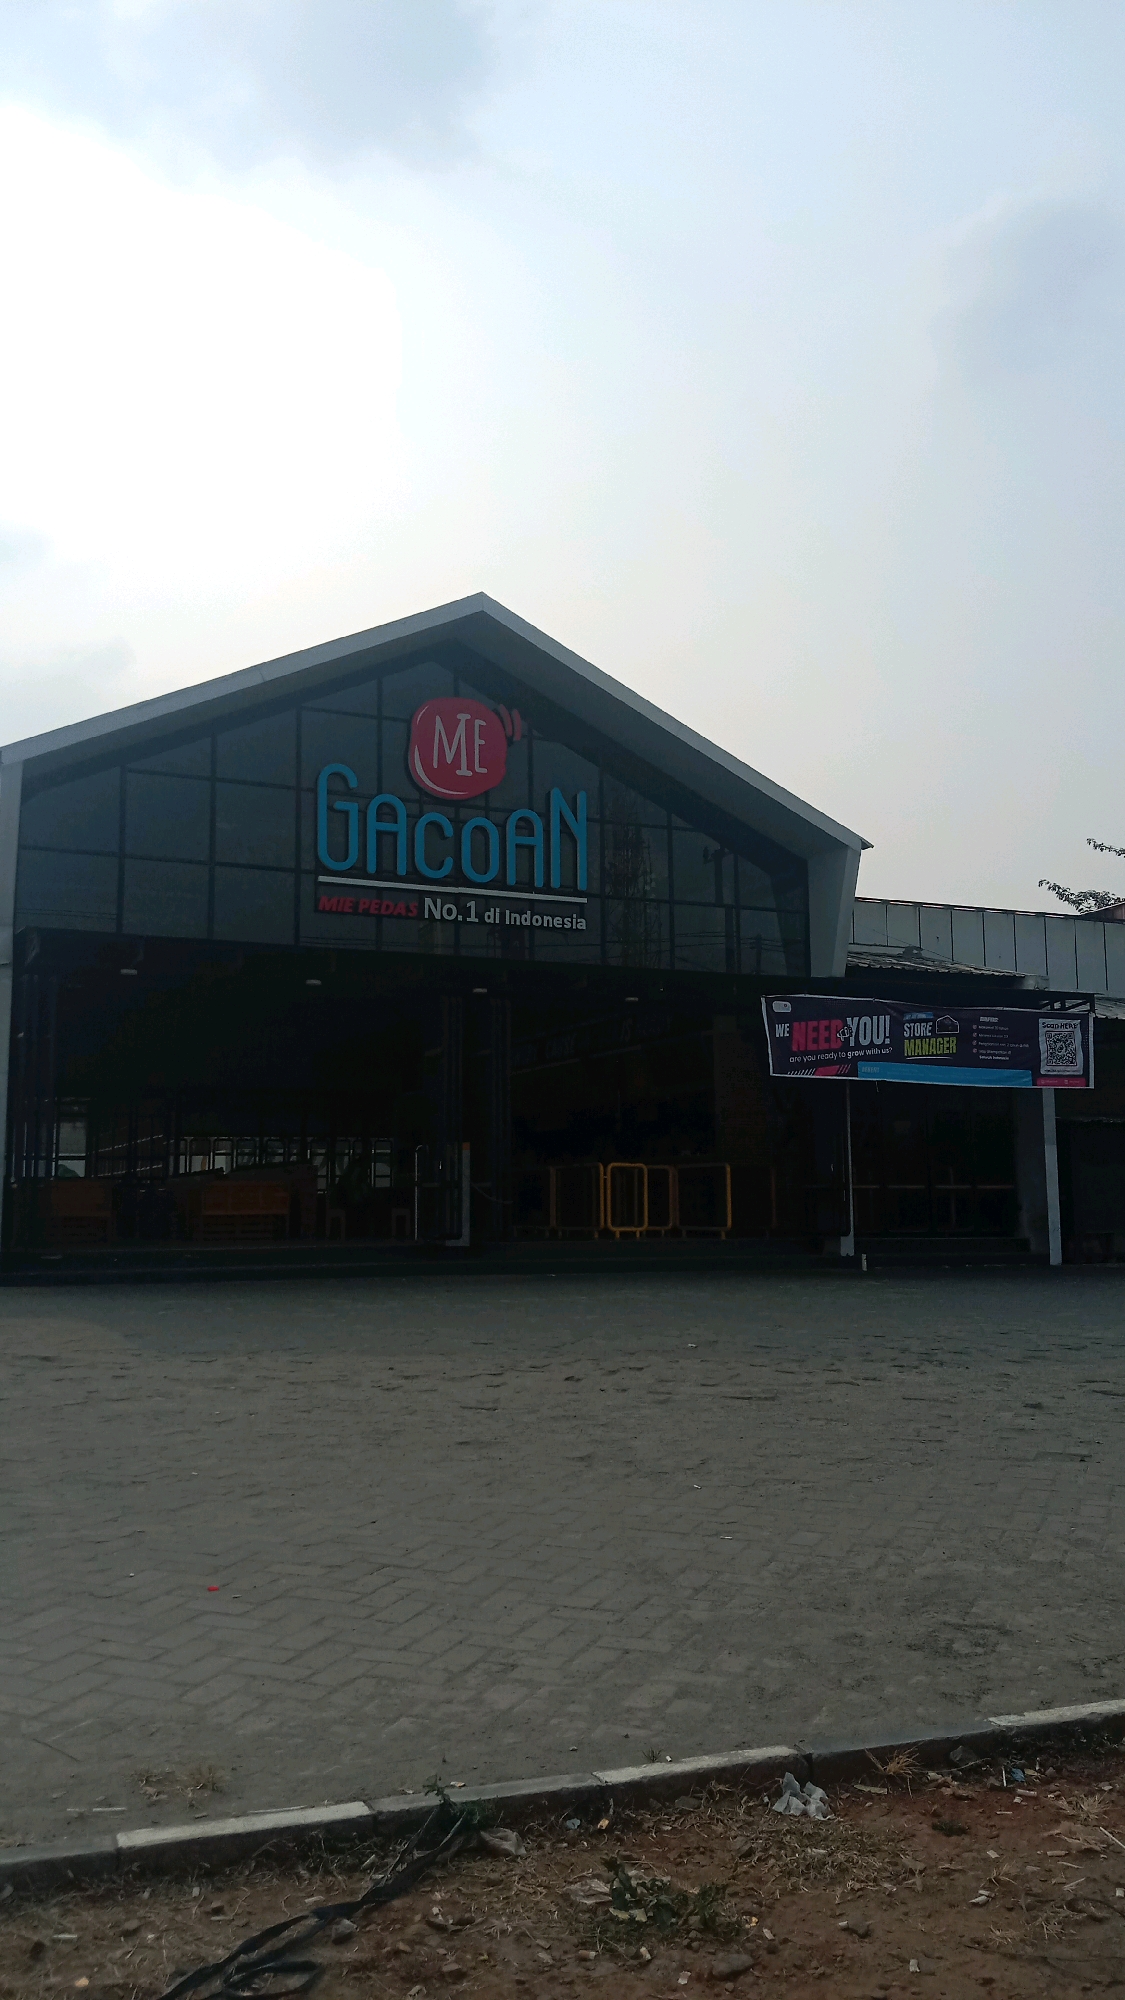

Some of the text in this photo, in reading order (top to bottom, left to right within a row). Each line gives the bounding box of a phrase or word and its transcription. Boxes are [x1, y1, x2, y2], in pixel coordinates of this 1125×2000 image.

[317, 762, 588, 891] GACOAN
[318, 895, 587, 930] MIE PEDAS No.1 di Indonesia
[775, 1014, 891, 1052] WE NEED YOU!
[903, 1021, 933, 1038] STORE
[1041, 1021, 1060, 1029] Scan
[803, 1055, 816, 1063] you
[817, 1051, 838, 1061] ready
[847, 1050, 865, 1059] grow
[865, 1048, 881, 1056] with
[904, 1036, 957, 1057] MANAGER
